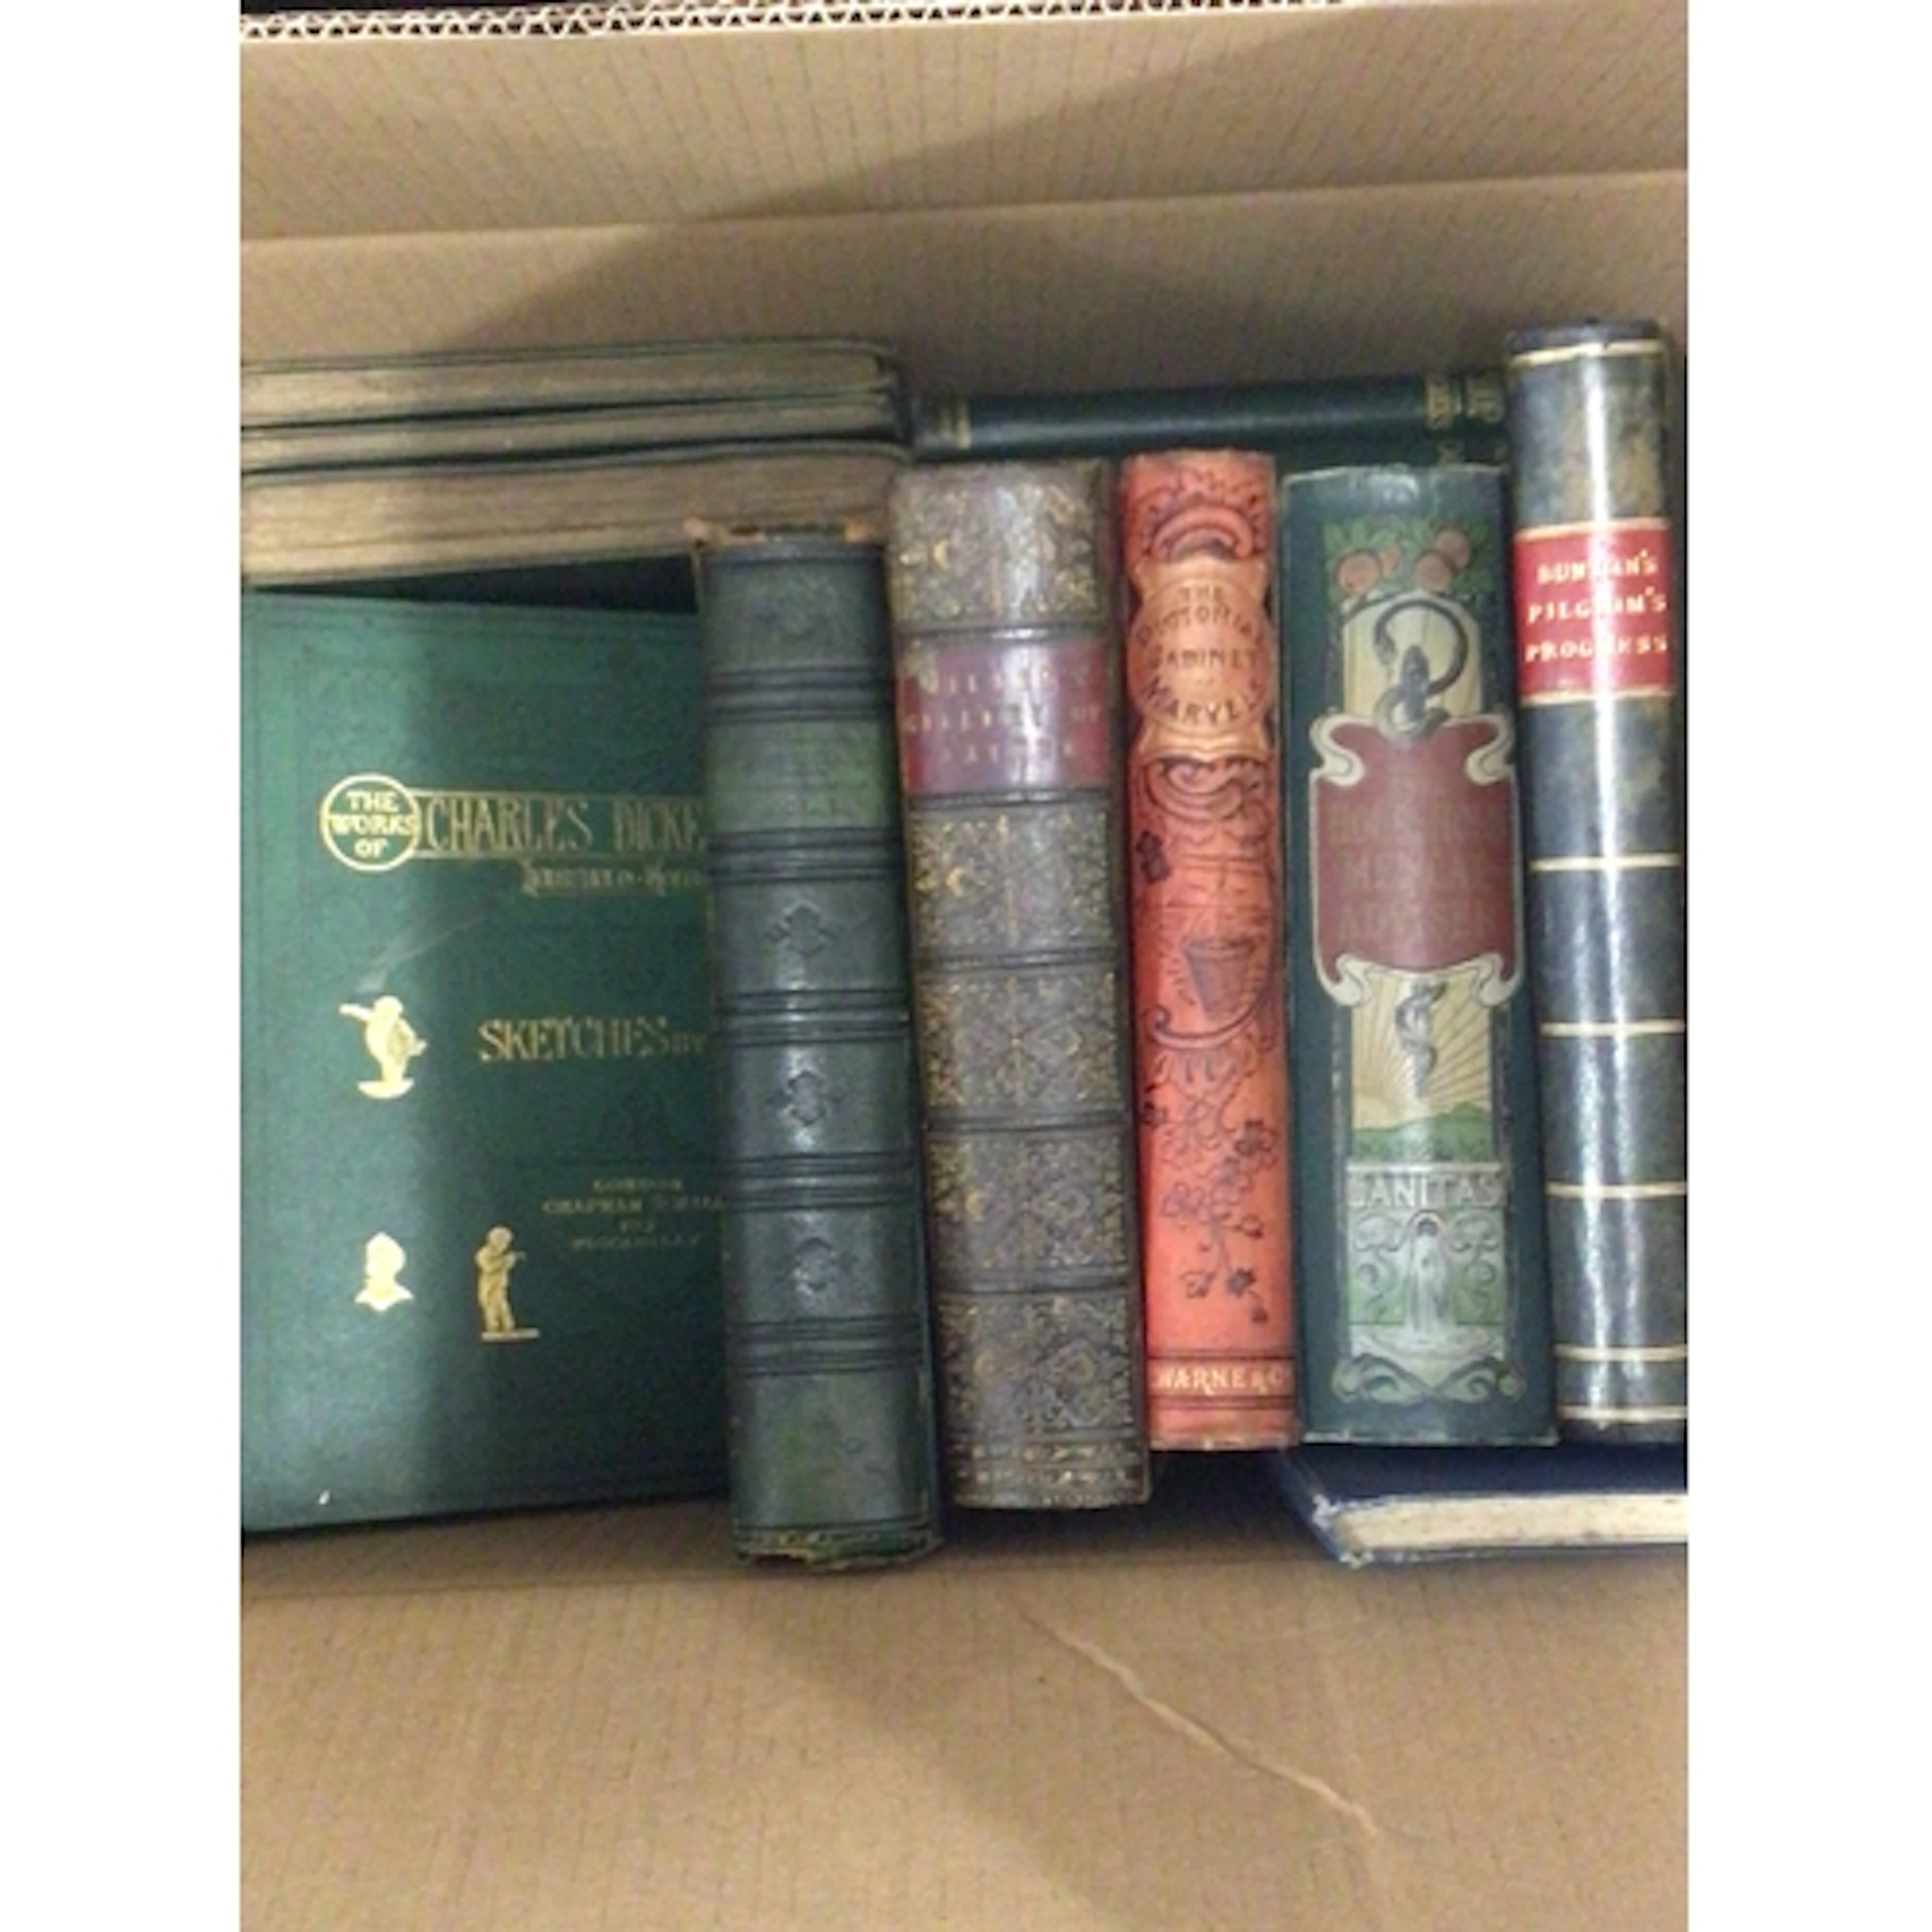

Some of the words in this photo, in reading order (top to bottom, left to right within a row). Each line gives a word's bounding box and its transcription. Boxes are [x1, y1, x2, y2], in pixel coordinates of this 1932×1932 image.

[1538, 548, 1659, 585] BUNAN'S
[1527, 587, 1667, 624] PILGIM'S
[1525, 635, 1667, 663] PROGESS
[347, 790, 399, 812] THE
[329, 813, 419, 836] WORKS
[426, 797, 594, 853] CHARLES
[354, 837, 390, 859] OF
[478, 1015, 670, 1062] SKETCHES
[1347, 1174, 1501, 1209] SANITAS
